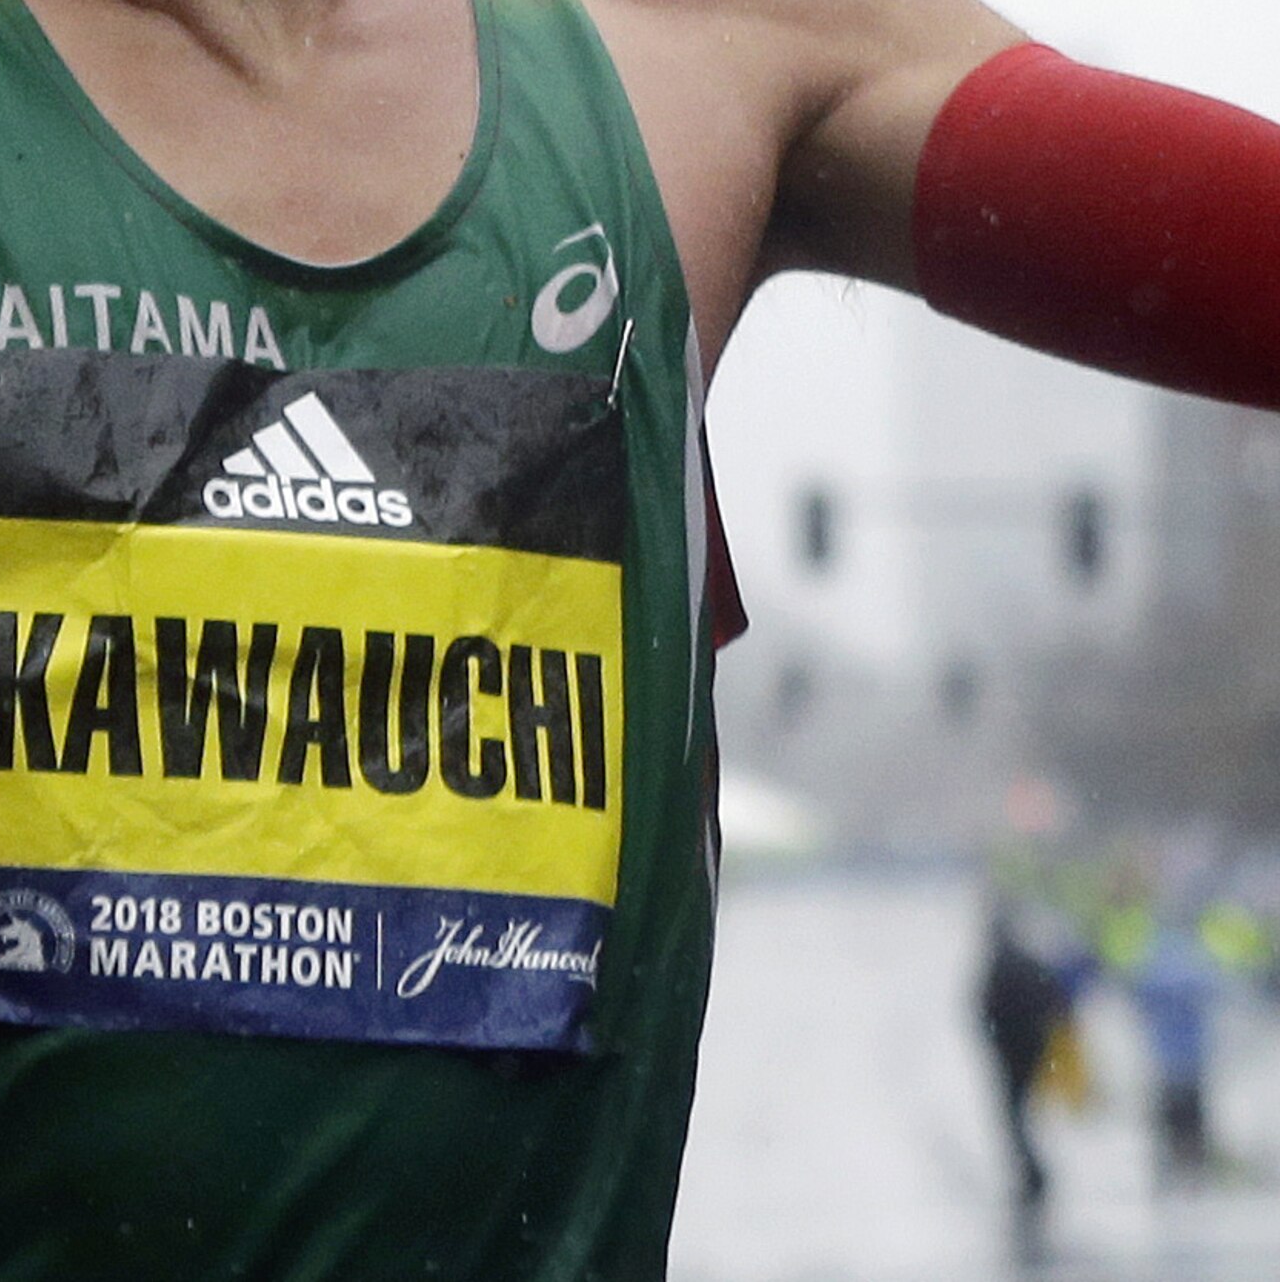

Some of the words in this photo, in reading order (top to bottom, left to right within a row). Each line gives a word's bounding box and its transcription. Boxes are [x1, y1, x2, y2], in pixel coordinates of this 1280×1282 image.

[202, 474, 413, 528] adidas
[90, 894, 182, 935] 2018
[196, 898, 352, 945] BOSTON
[89, 936, 353, 990] MARATHON
[396, 916, 489, 998] John
